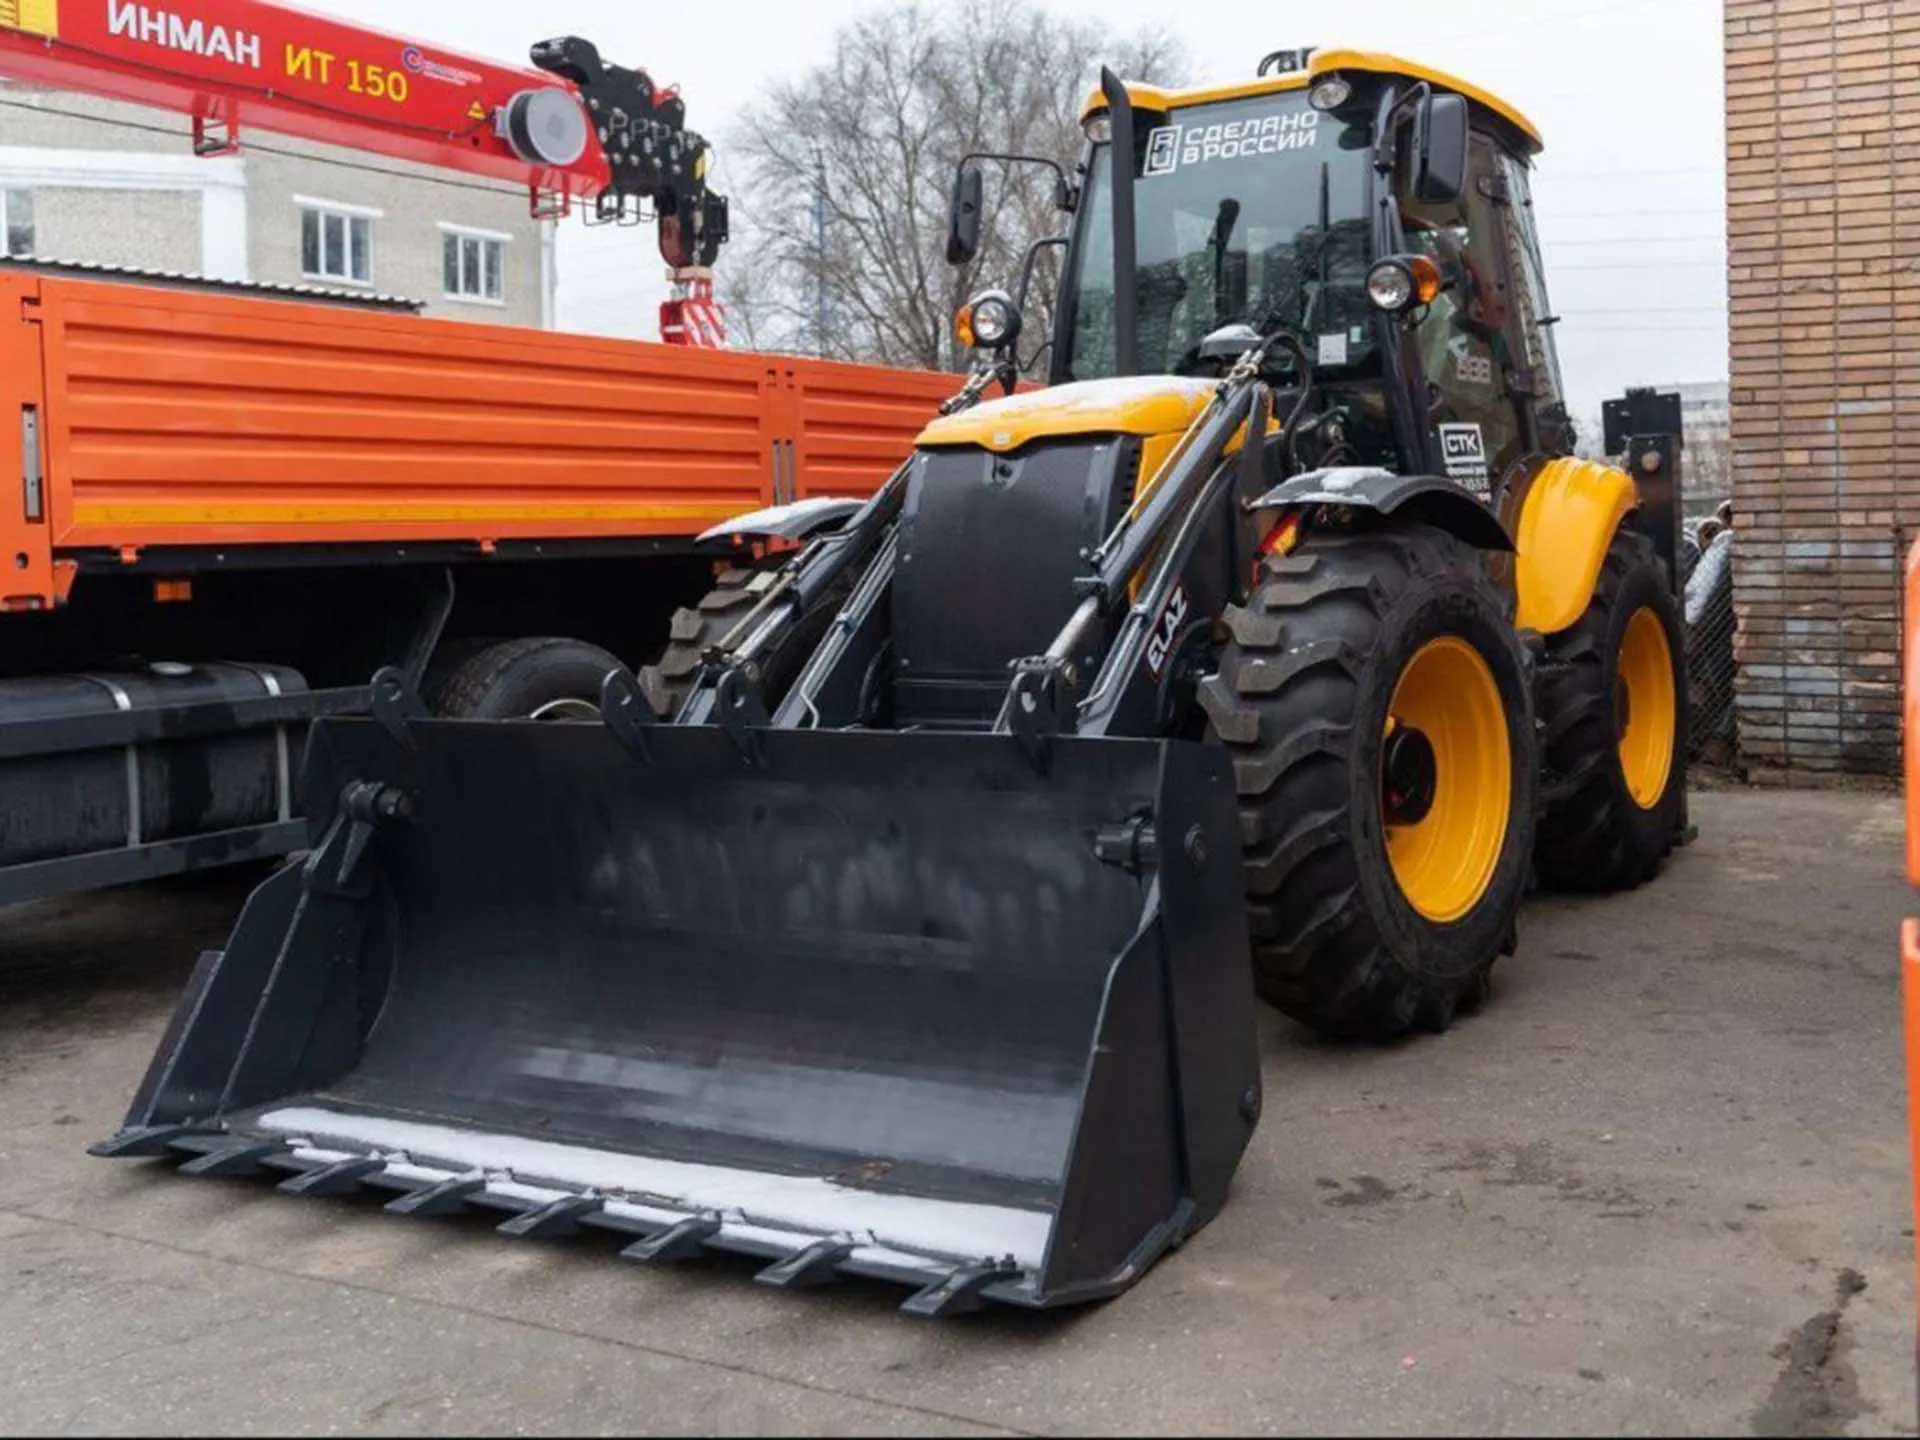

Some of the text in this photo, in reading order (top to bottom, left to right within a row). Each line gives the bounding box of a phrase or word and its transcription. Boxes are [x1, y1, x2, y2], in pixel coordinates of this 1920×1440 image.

[107, 0, 261, 68] ИНМАН
[285, 43, 335, 85] ИТ
[347, 60, 408, 103] 150
[1185, 110, 1319, 145] СДЕЛАНО
[1203, 129, 1317, 161] РОССИИ
[1446, 433, 1478, 452] СТК
[1147, 586, 1188, 673] ELAZ
